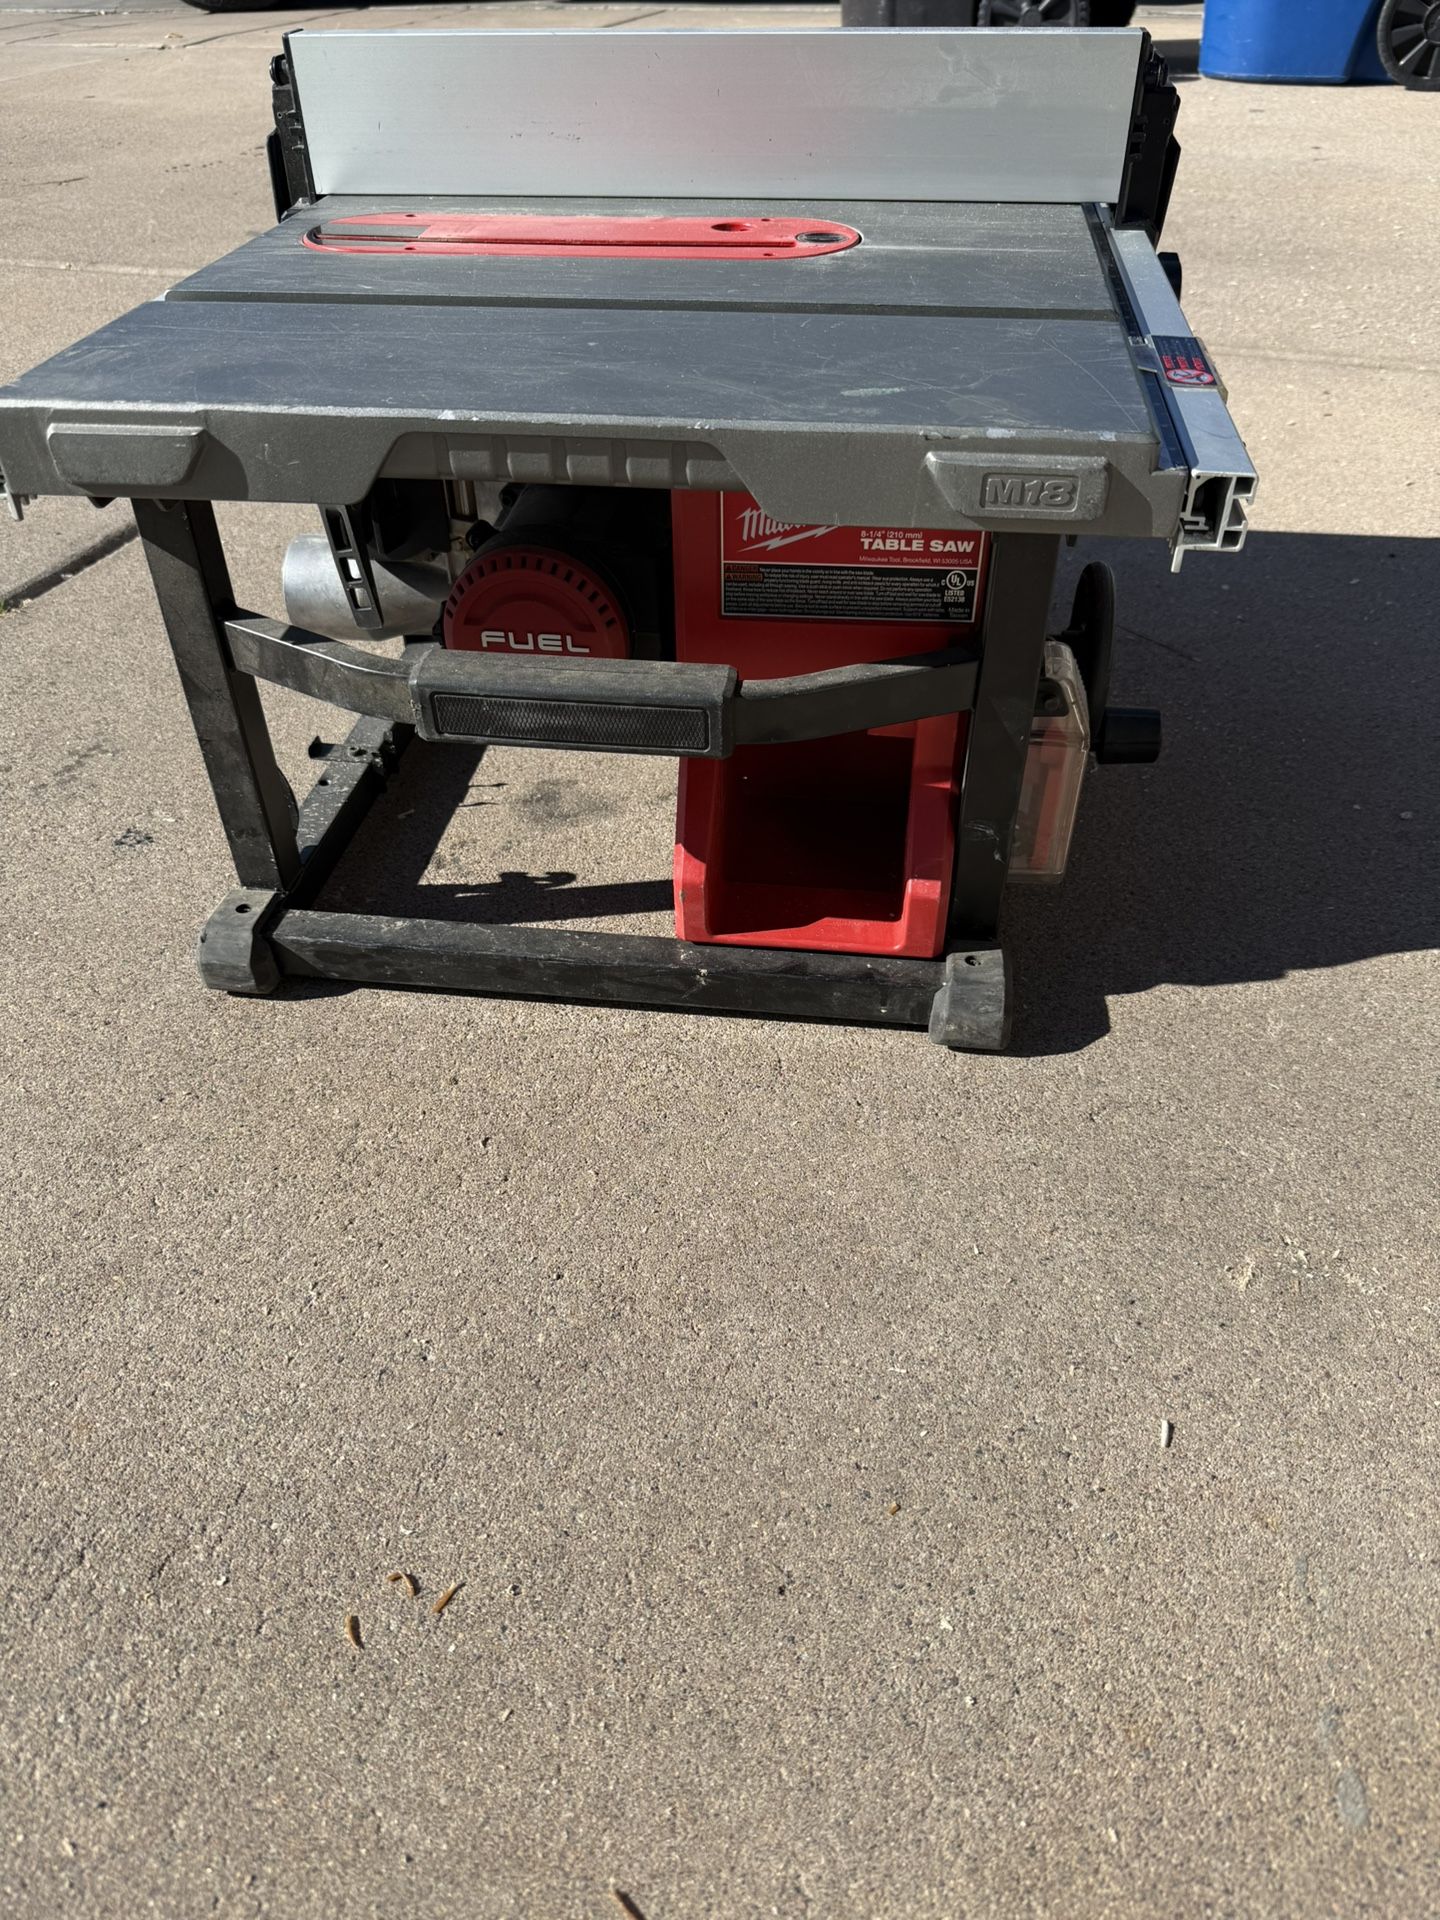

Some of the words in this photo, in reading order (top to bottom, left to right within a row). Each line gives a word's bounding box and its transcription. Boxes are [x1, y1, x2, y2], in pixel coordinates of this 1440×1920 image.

[986, 478, 1076, 507] M18
[886, 531, 904, 539] (210
[860, 538, 925, 551] TABLE
[929, 540, 975, 553] SAW
[951, 574, 961, 586] UL
[480, 630, 590, 653] FUEL
